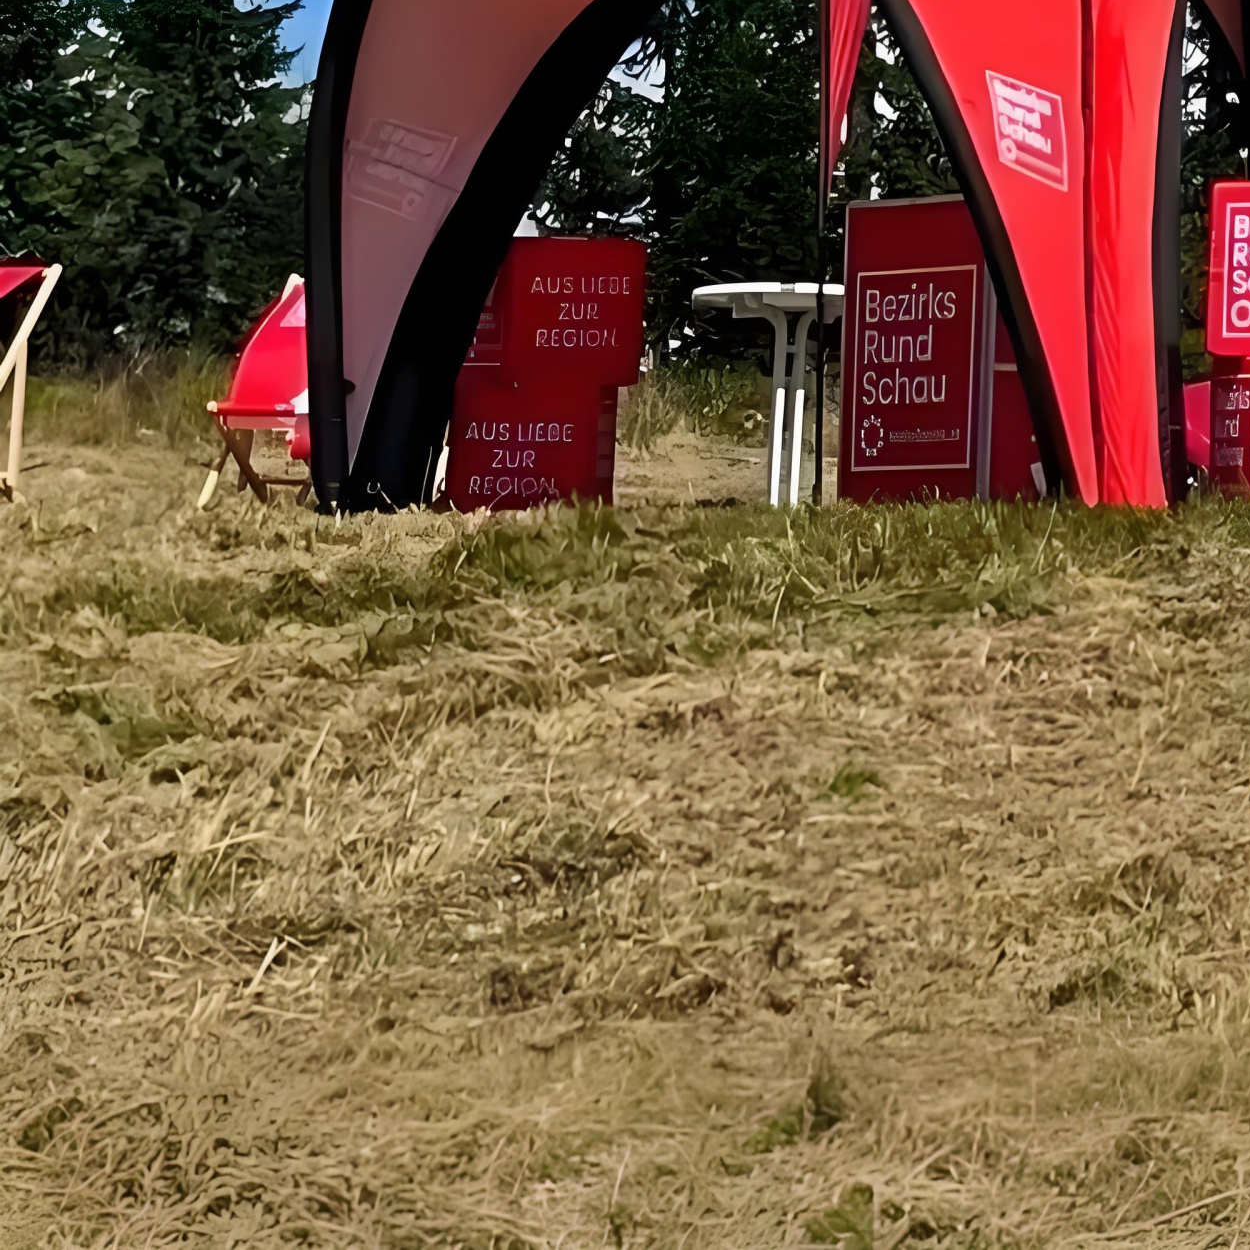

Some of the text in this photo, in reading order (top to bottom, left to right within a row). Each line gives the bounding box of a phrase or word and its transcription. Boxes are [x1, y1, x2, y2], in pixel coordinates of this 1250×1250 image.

[531, 276, 630, 295] AUS LIEBE
[559, 303, 598, 320] ZUR
[865, 283, 956, 323] Bezirks
[864, 325, 933, 364] Rund
[863, 368, 946, 405] Schau
[466, 422, 509, 441] AUS
[492, 450, 535, 468] ZUR
